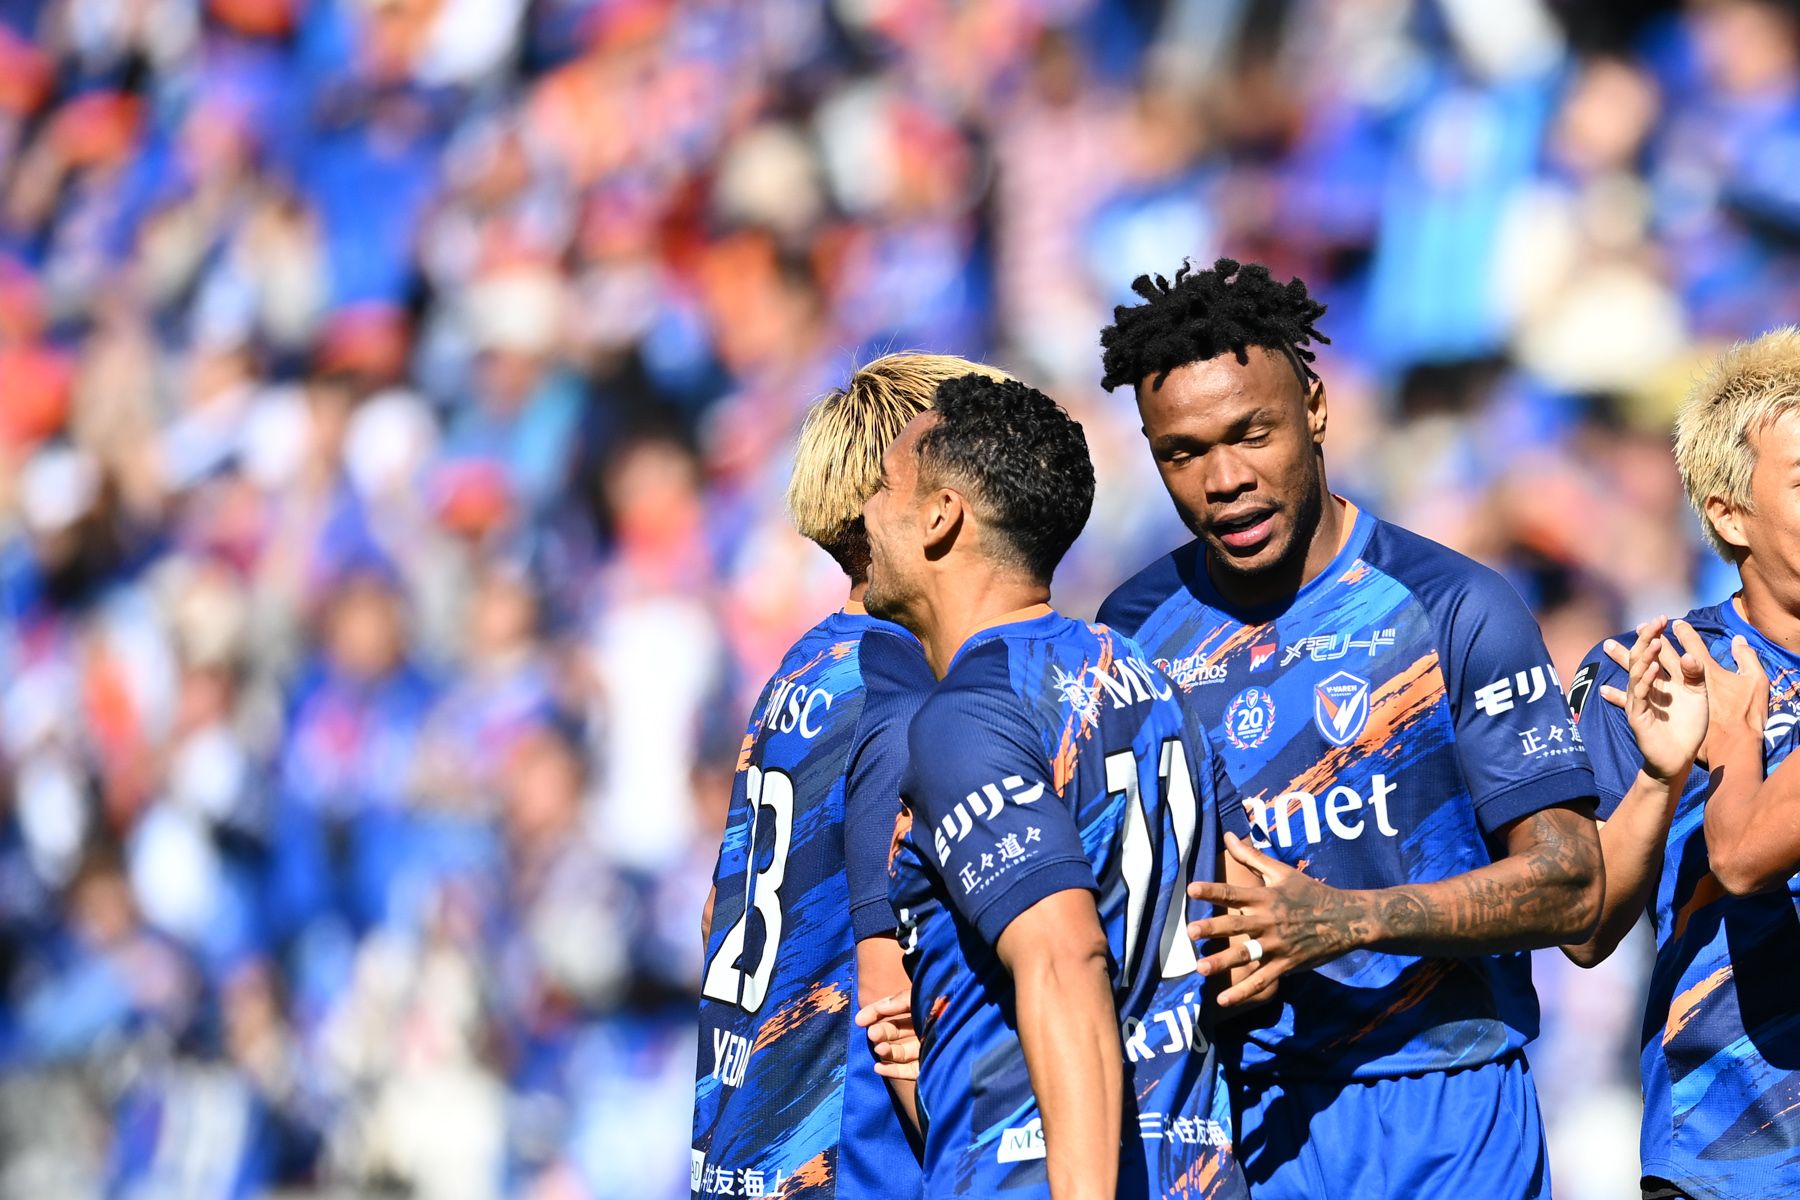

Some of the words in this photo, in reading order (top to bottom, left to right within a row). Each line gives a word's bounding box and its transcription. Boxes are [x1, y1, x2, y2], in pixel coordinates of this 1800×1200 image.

[1173, 653, 1207, 676] trans
[1238, 707, 1263, 731] 20
[959, 827, 1041, 894] 正々道々
